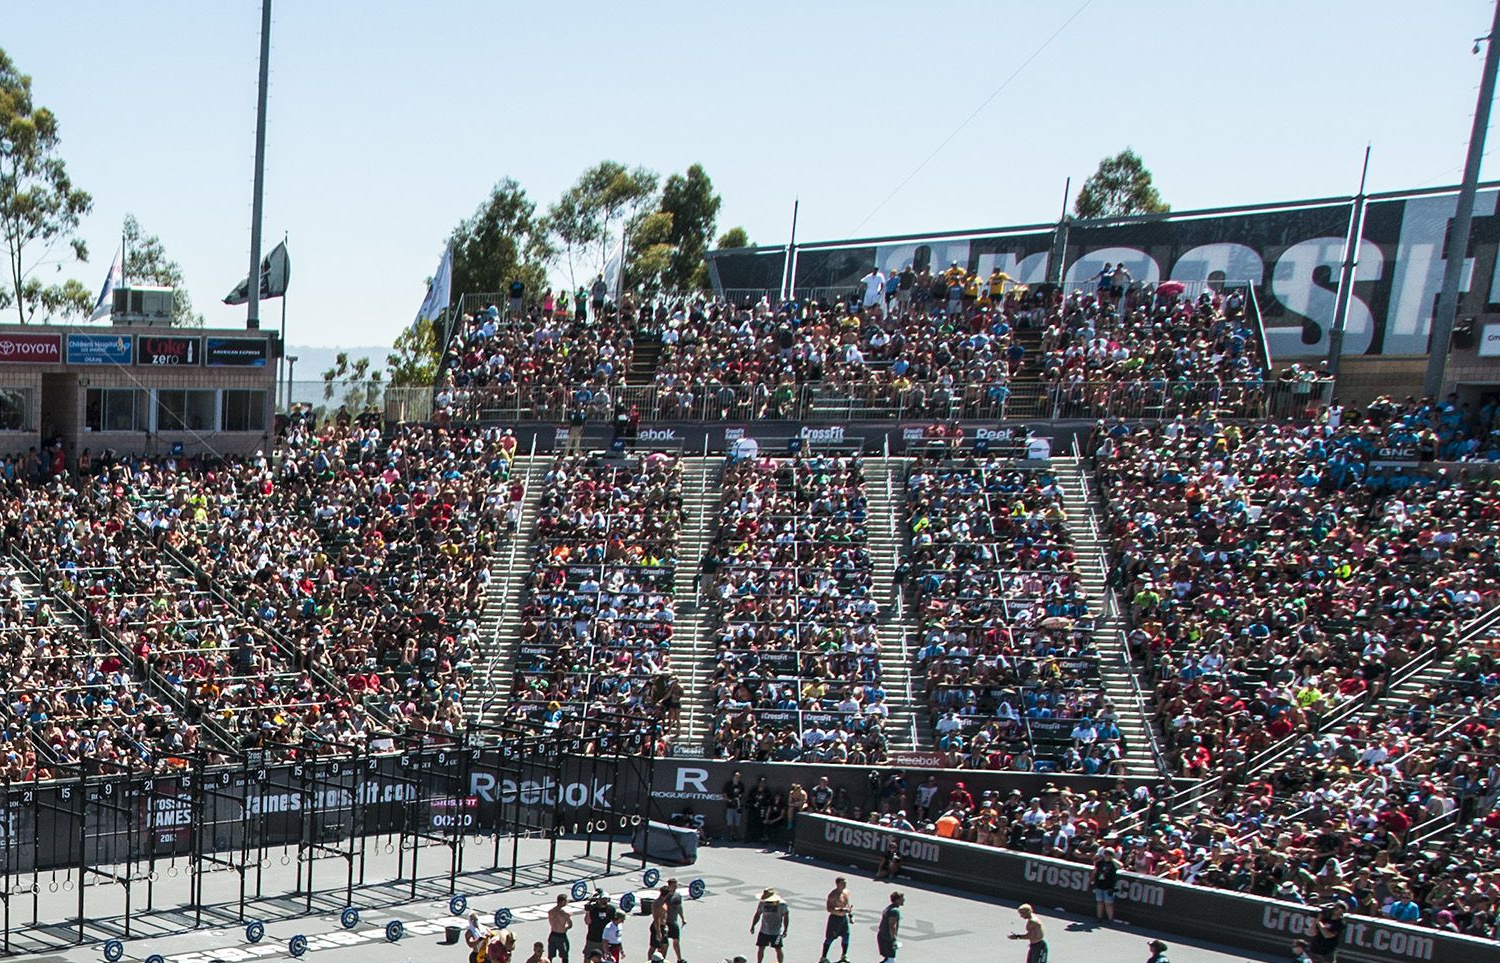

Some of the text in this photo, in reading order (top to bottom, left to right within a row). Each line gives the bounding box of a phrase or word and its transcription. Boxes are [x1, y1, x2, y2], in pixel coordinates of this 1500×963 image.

[14, 342, 58, 355] TOYOTA
[146, 336, 186, 355] Coke
[152, 353, 179, 365] zero
[801, 426, 845, 440] CrossFit
[976, 427, 1036, 442] Reebk
[401, 756, 409, 766] 15
[438, 752, 445, 764] 9
[294, 765, 303, 776] 15
[332, 762, 339, 773] 9
[369, 759, 378, 770] 21
[222, 773, 229, 784] 9
[257, 769, 266, 780] 21
[144, 780, 153, 791] 21
[182, 776, 190, 787] 15
[61, 787, 71, 799] 15
[104, 783, 112, 795] 9
[470, 772, 614, 809] Reebok
[24, 791, 33, 802] 21
[824, 822, 940, 863] CrossFicom
[1263, 904, 1435, 961] Crosit.com
